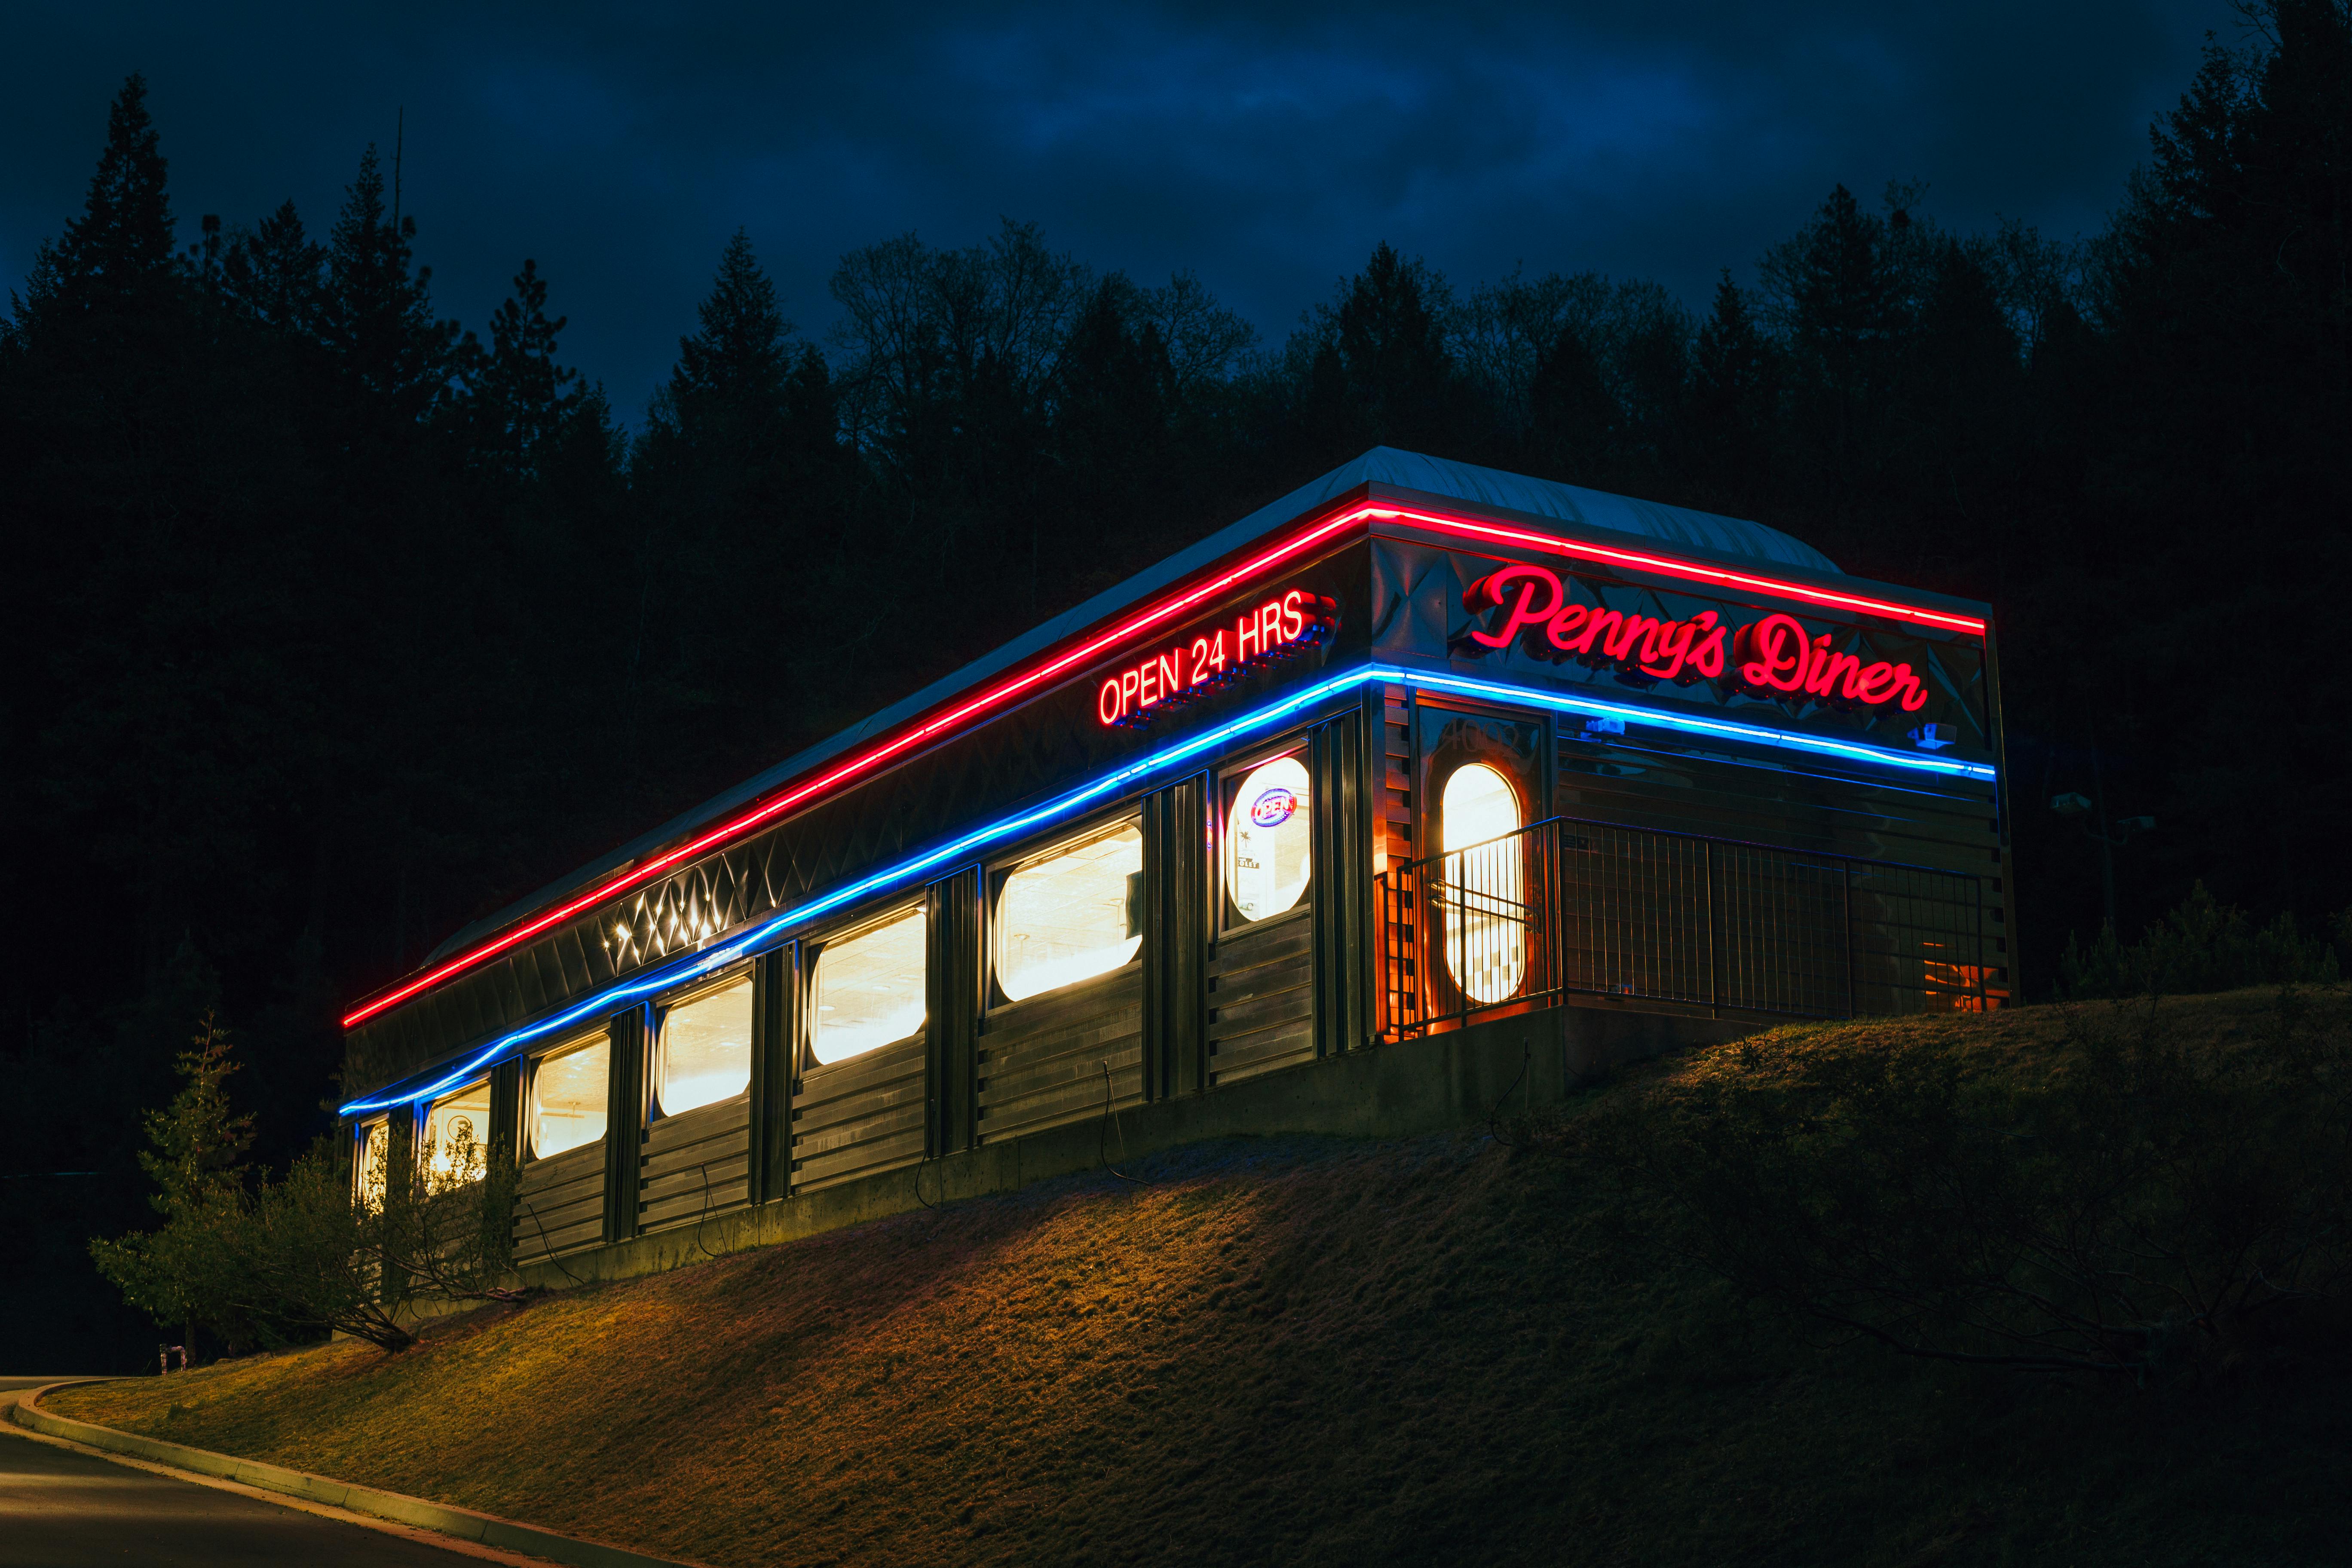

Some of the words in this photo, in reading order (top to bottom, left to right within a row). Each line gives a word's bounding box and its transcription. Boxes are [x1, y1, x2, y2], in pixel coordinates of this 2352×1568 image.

[1100, 649, 1179, 724] OPEN
[1191, 630, 1225, 685] 24
[1239, 591, 1303, 662] HRS
[1473, 566, 1727, 678] Penny's
[1743, 614, 1928, 711] Diner
[1254, 794, 1289, 818] OPEN
